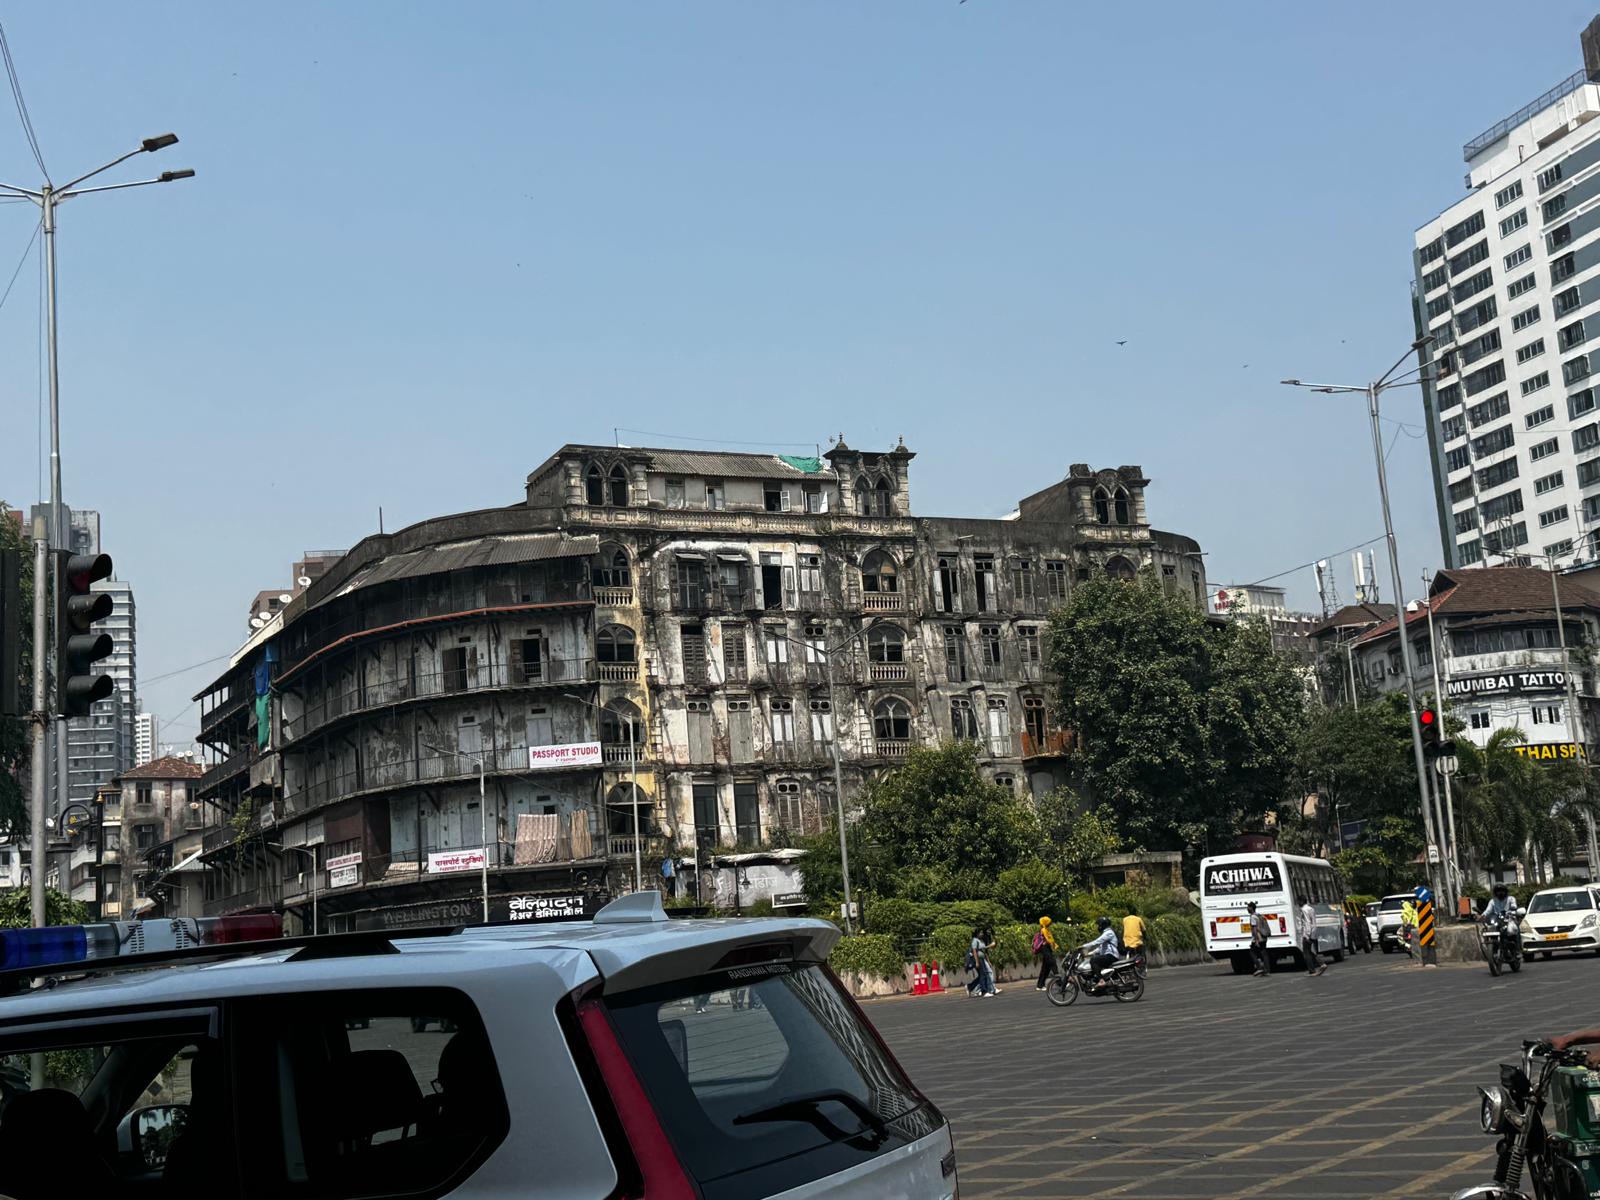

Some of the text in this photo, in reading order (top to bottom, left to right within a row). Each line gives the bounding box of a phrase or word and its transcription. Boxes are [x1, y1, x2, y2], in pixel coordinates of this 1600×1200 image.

[1447, 675, 1515, 695] MUMBAI
[532, 746, 599, 760] PASSPORT STUDIO
[1515, 744, 1557, 760] THAI
